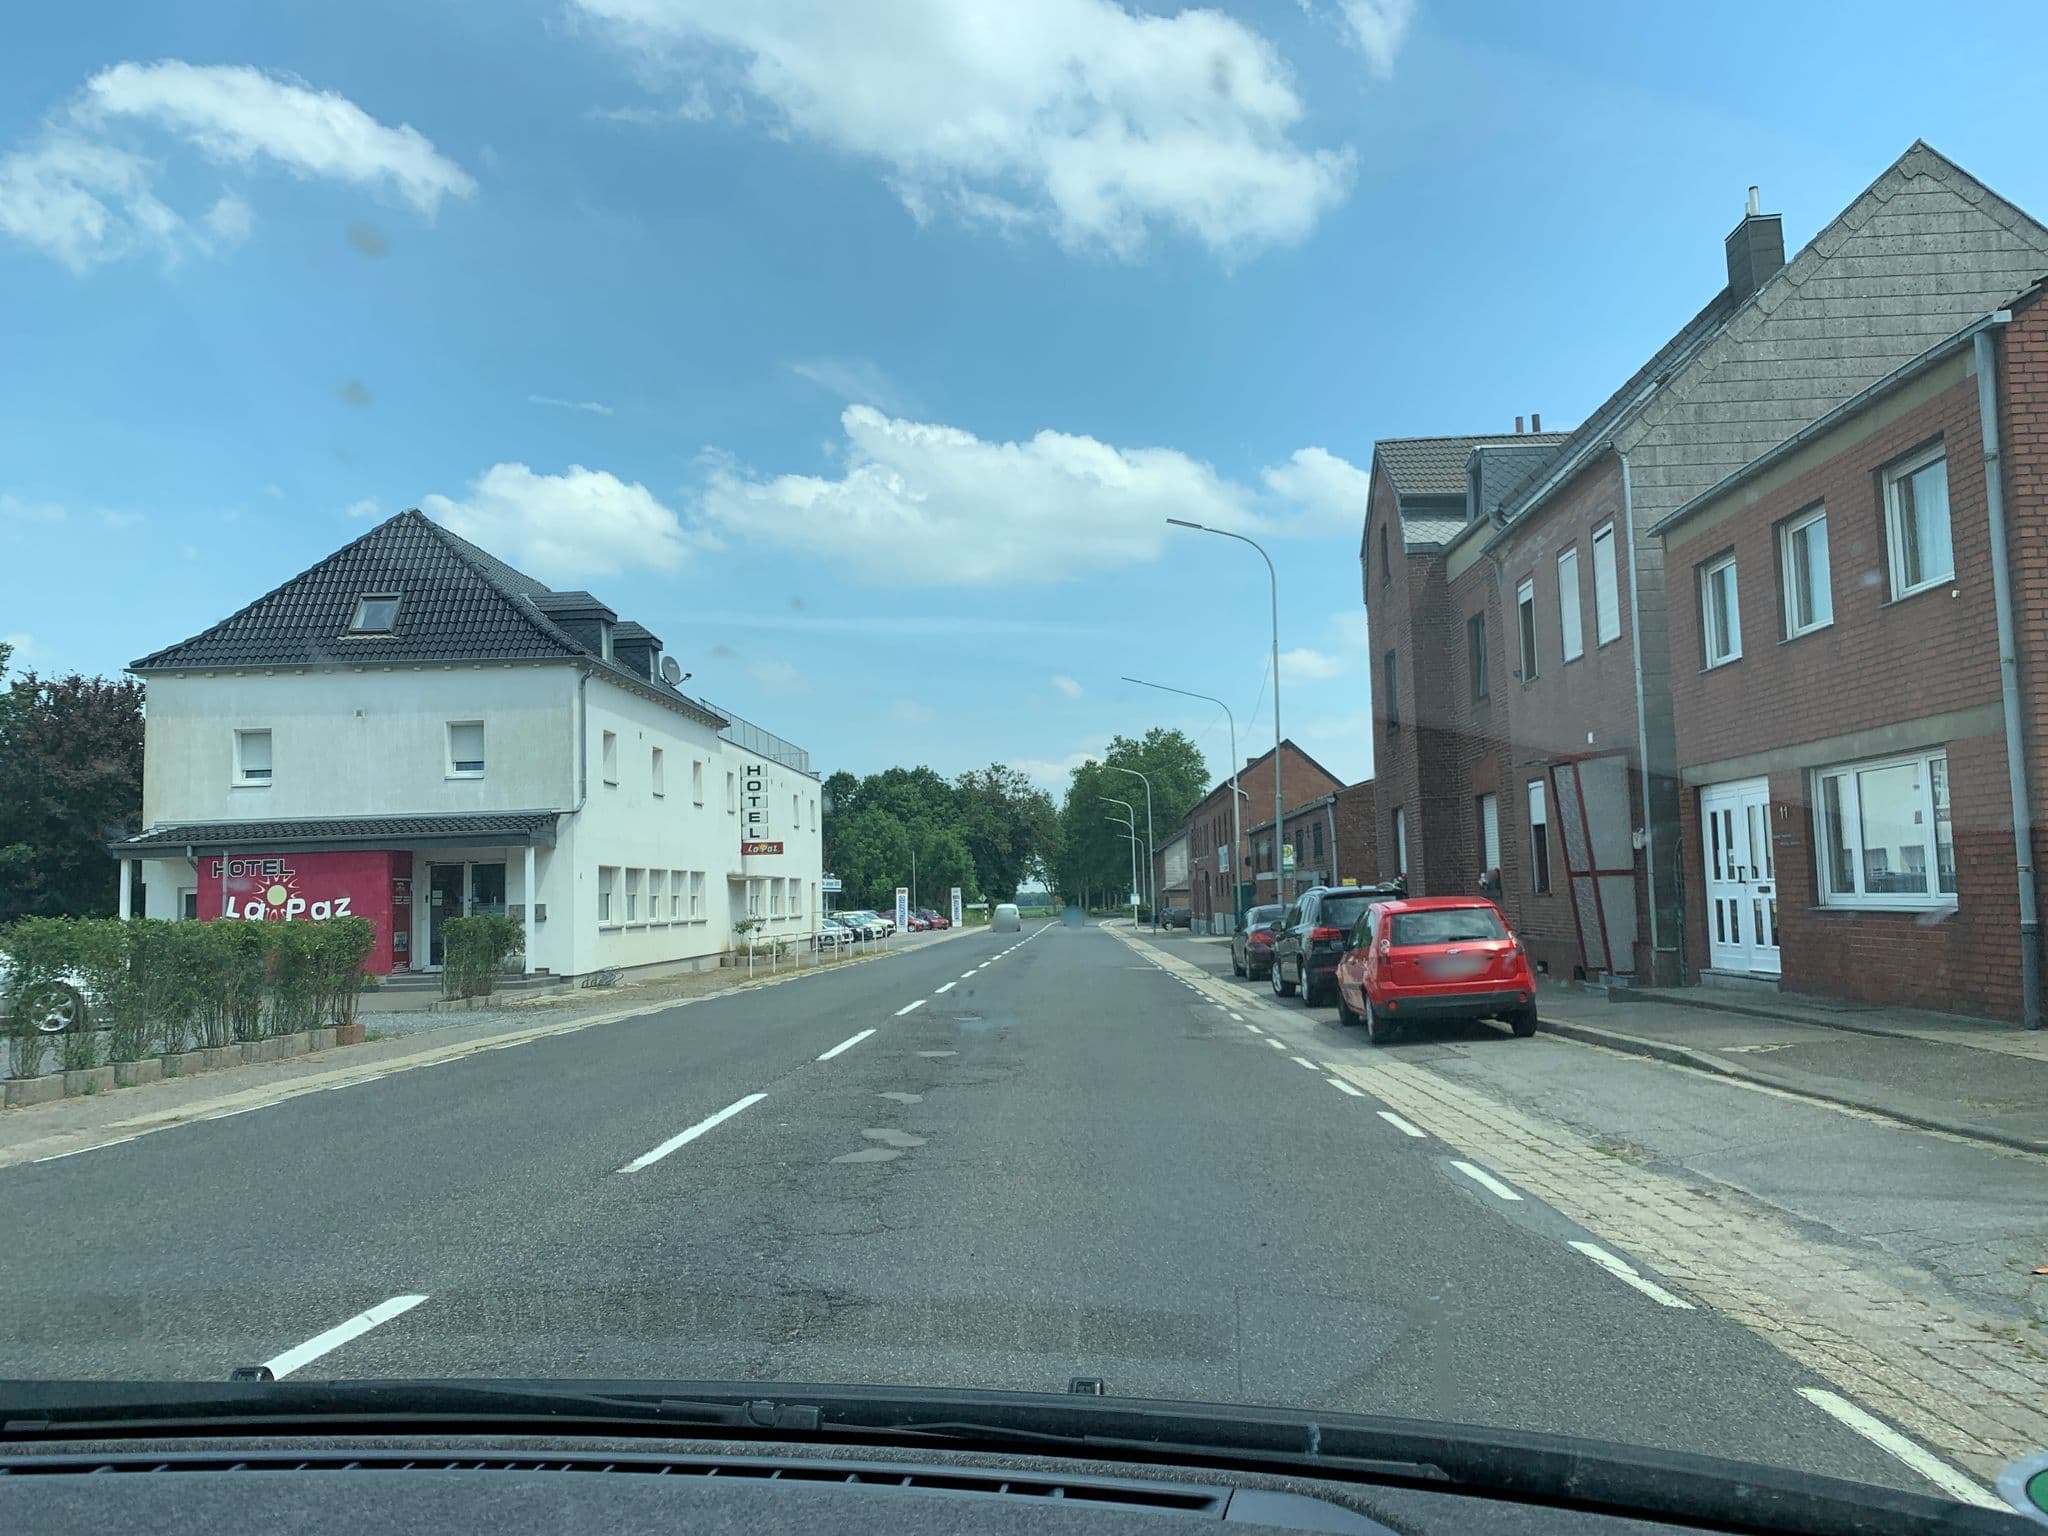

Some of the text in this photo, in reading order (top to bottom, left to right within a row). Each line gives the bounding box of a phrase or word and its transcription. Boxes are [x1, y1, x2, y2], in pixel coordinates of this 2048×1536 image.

[747, 765, 761, 838] HOTEL
[1780, 805, 1788, 820] 11
[748, 844, 759, 852] La
[211, 858, 296, 879] HOTEL
[225, 896, 352, 922] La Paz
